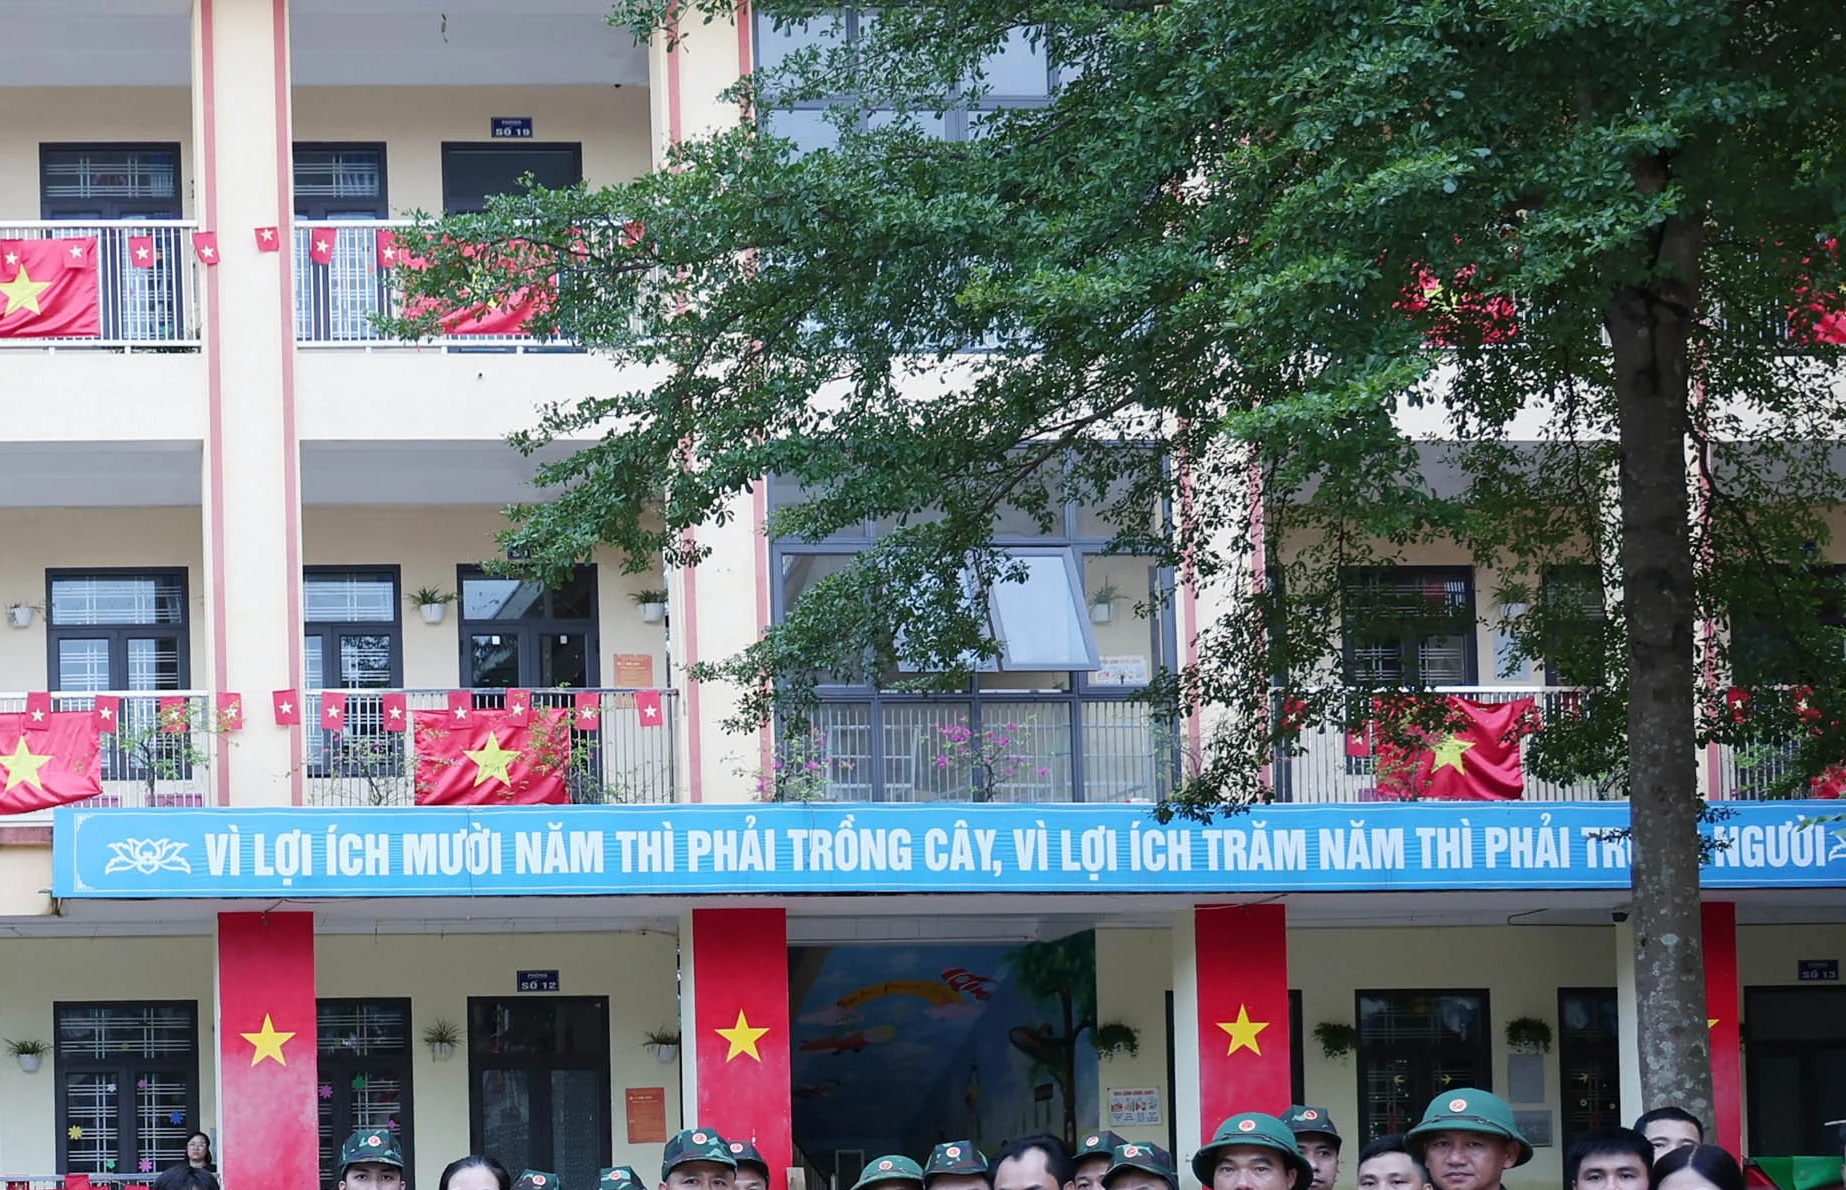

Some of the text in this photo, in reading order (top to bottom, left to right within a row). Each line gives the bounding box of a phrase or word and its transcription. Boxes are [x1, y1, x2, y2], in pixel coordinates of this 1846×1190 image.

[205, 824, 241, 876] VÌ
[254, 828, 312, 886] LỢI
[326, 824, 390, 876] ÍCH
[403, 822, 502, 876] MƯỜI
[515, 821, 604, 875] NĂM
[615, 821, 674, 872] THÌ
[687, 815, 776, 872] PHẢI
[787, 814, 912, 872] TRỒNG
[924, 819, 1002, 877] CÂY,
[1013, 819, 1049, 871] VÌ
[1061, 825, 1118, 881] LỢI
[1130, 820, 1191, 871] ÍCH
[1201, 820, 1306, 871] TRĂM
[1318, 819, 1405, 870] NĂM
[1415, 818, 1473, 869] THÌ
[1485, 812, 1571, 869] PHẢI
[1713, 814, 1827, 868] NGƯỜI
[541, 982, 557, 990] 12
